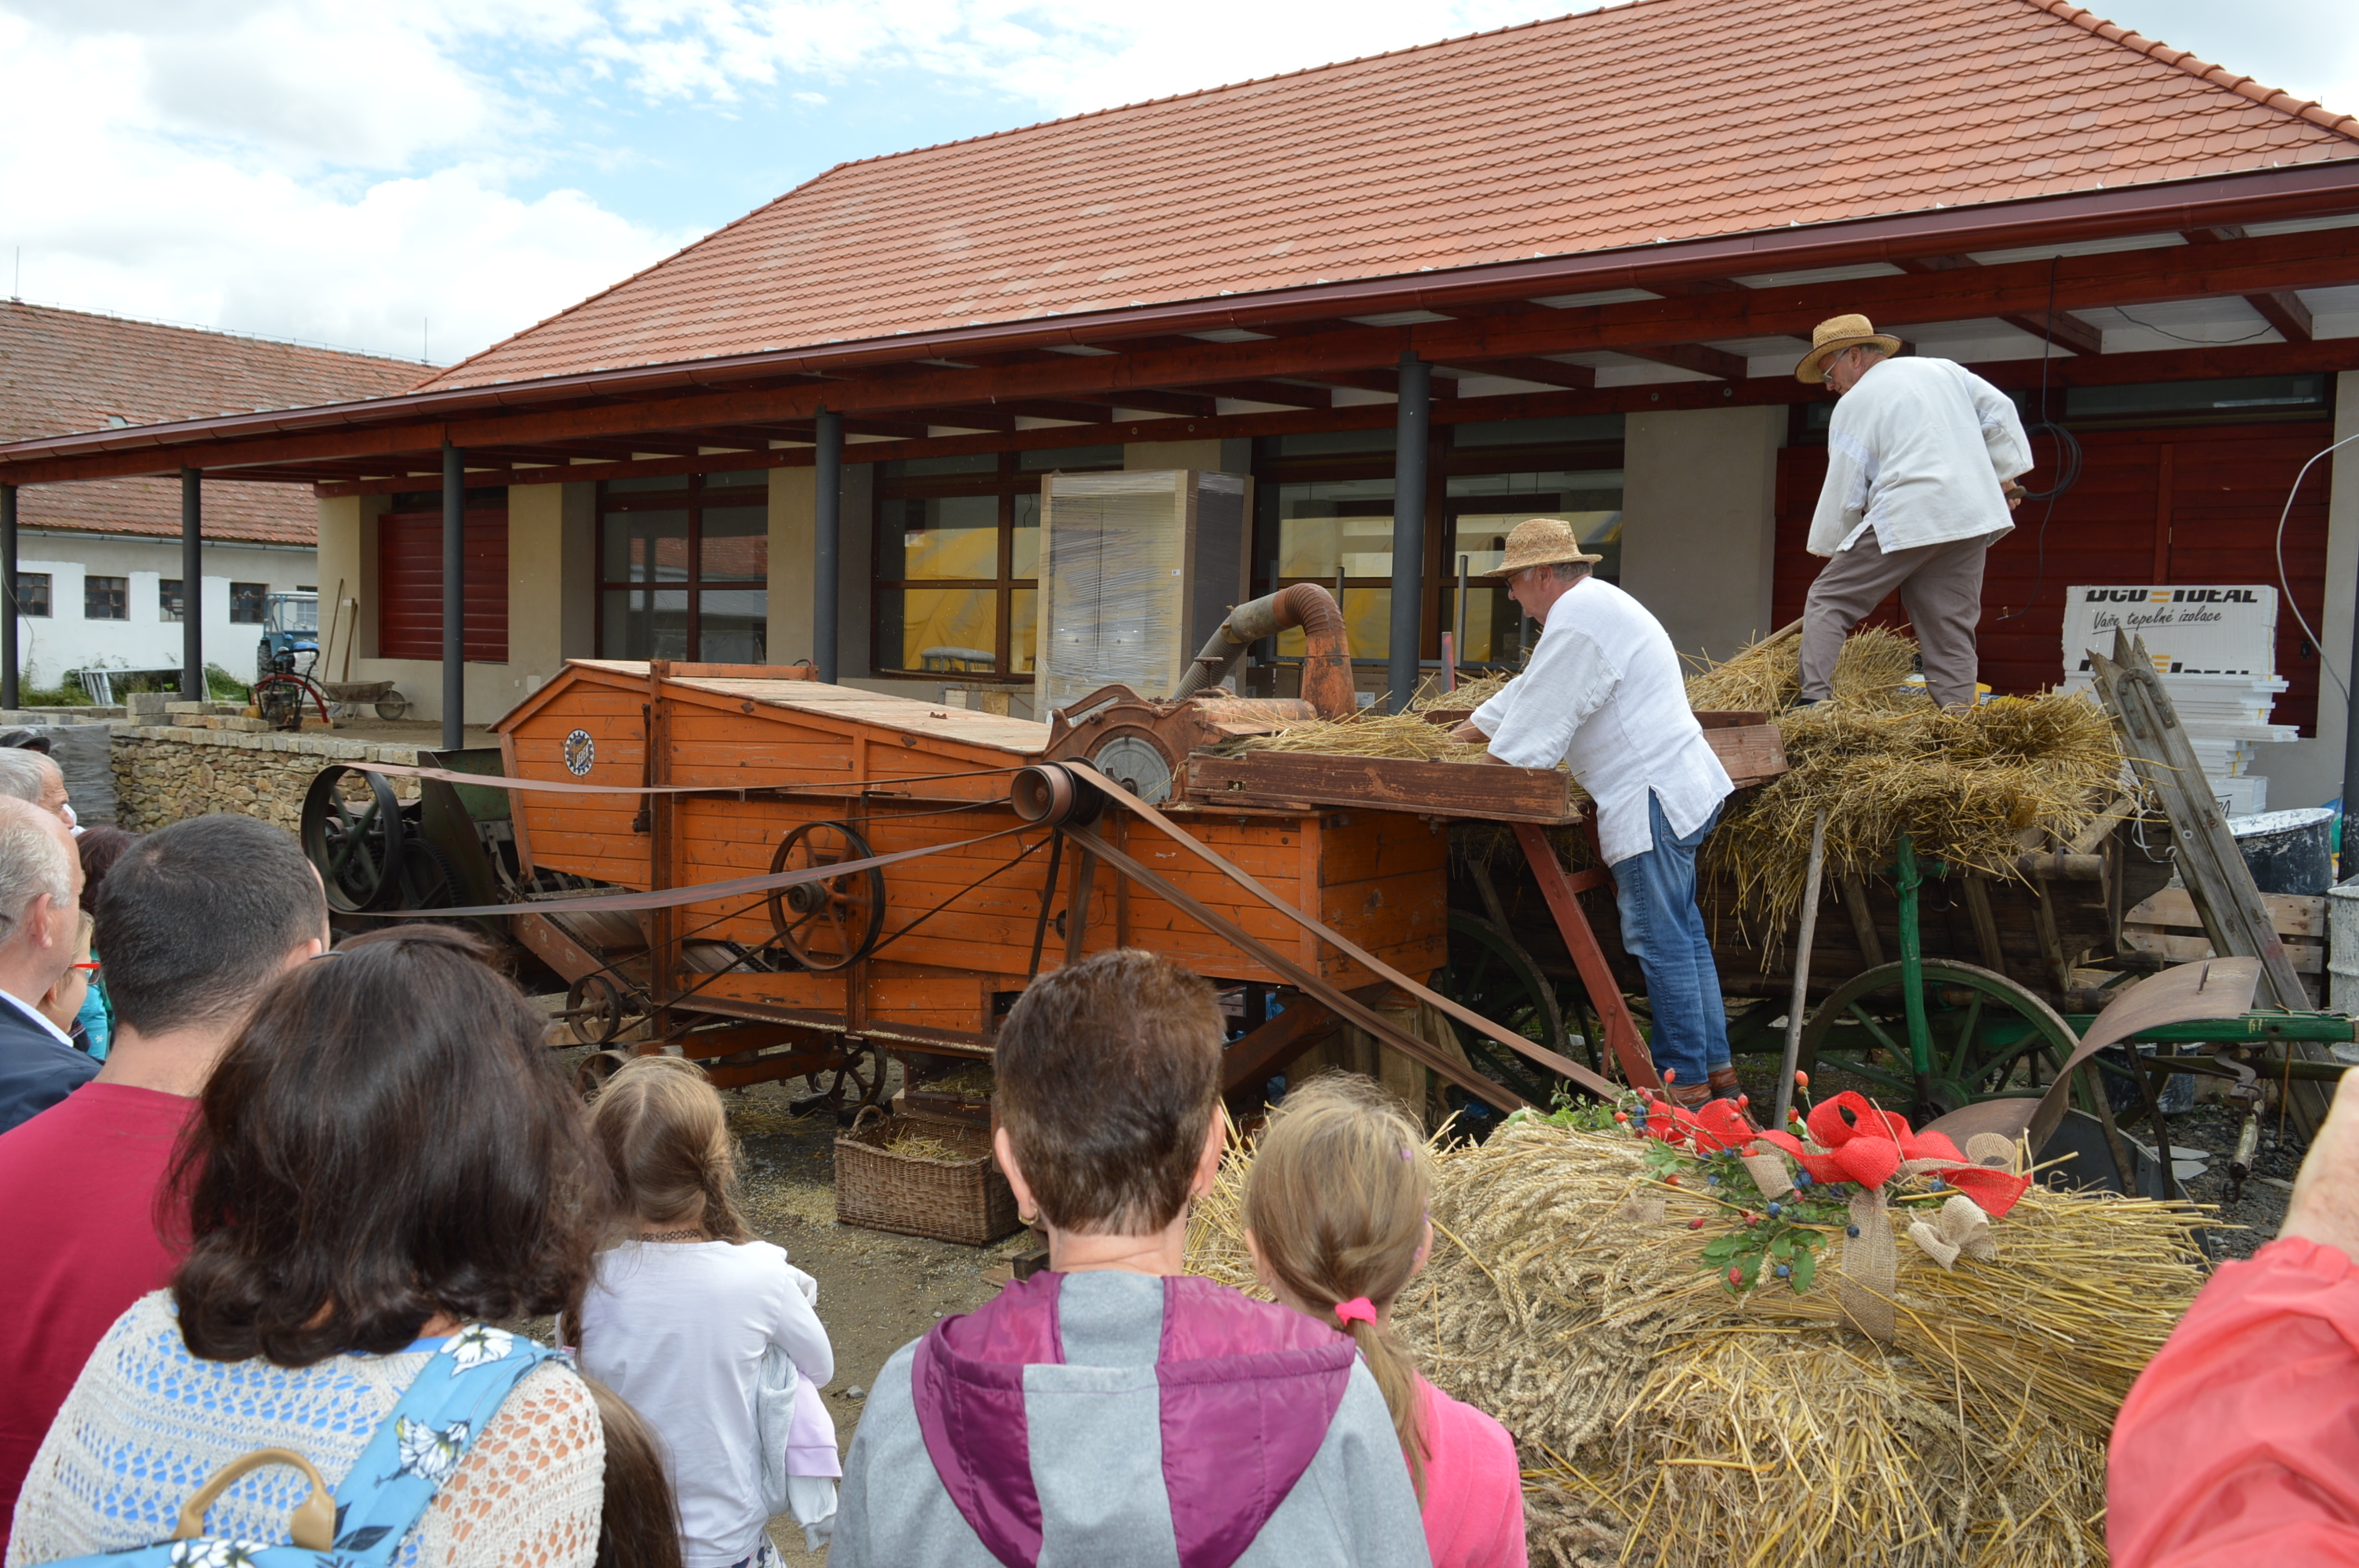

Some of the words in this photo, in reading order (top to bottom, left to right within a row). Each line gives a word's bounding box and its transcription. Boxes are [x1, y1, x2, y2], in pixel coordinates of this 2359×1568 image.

[2093, 611, 2121, 630] Vaše
[2127, 607, 2175, 631] tepelné
[2178, 604, 2222, 622] izolace
